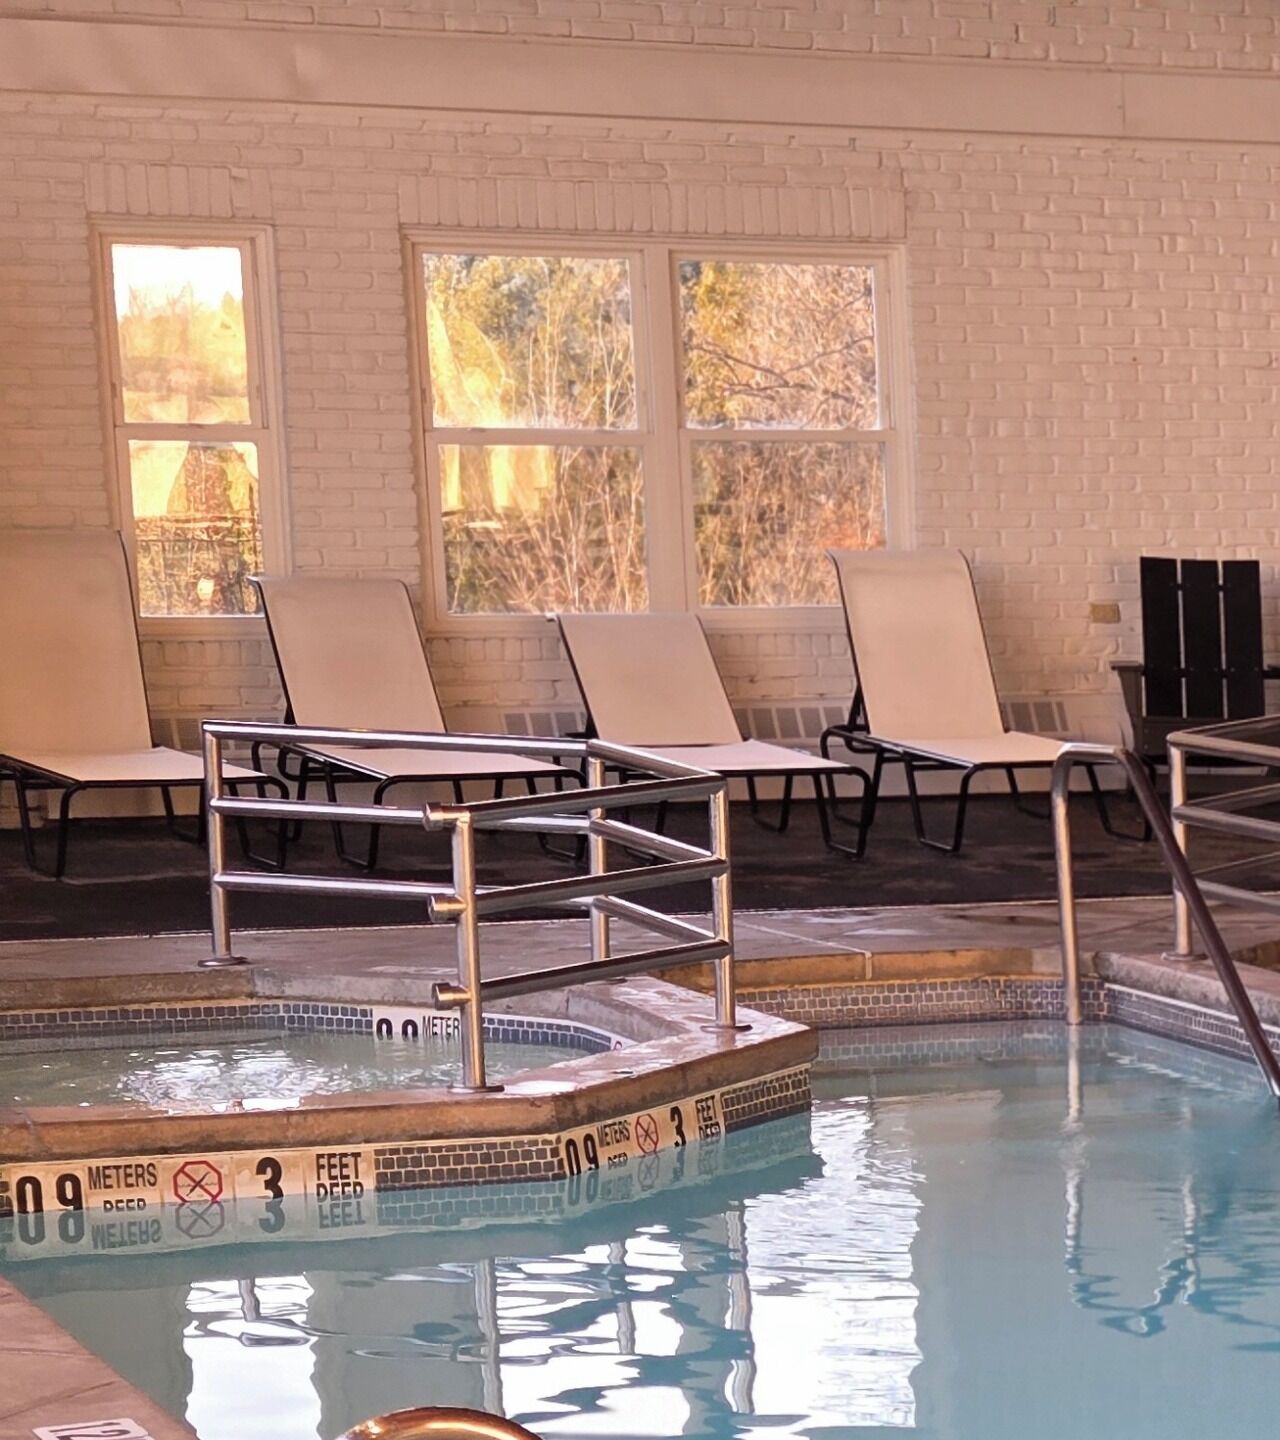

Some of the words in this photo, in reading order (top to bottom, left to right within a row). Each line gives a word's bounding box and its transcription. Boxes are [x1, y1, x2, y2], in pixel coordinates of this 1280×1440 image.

[423, 1016, 460, 1037] METER
[596, 1119, 631, 1148] METERS
[669, 1106, 687, 1147] 3
[695, 1095, 716, 1124] FEET
[88, 1162, 157, 1190] METERS
[255, 1157, 284, 1201] 3
[316, 1152, 362, 1182] FEET
